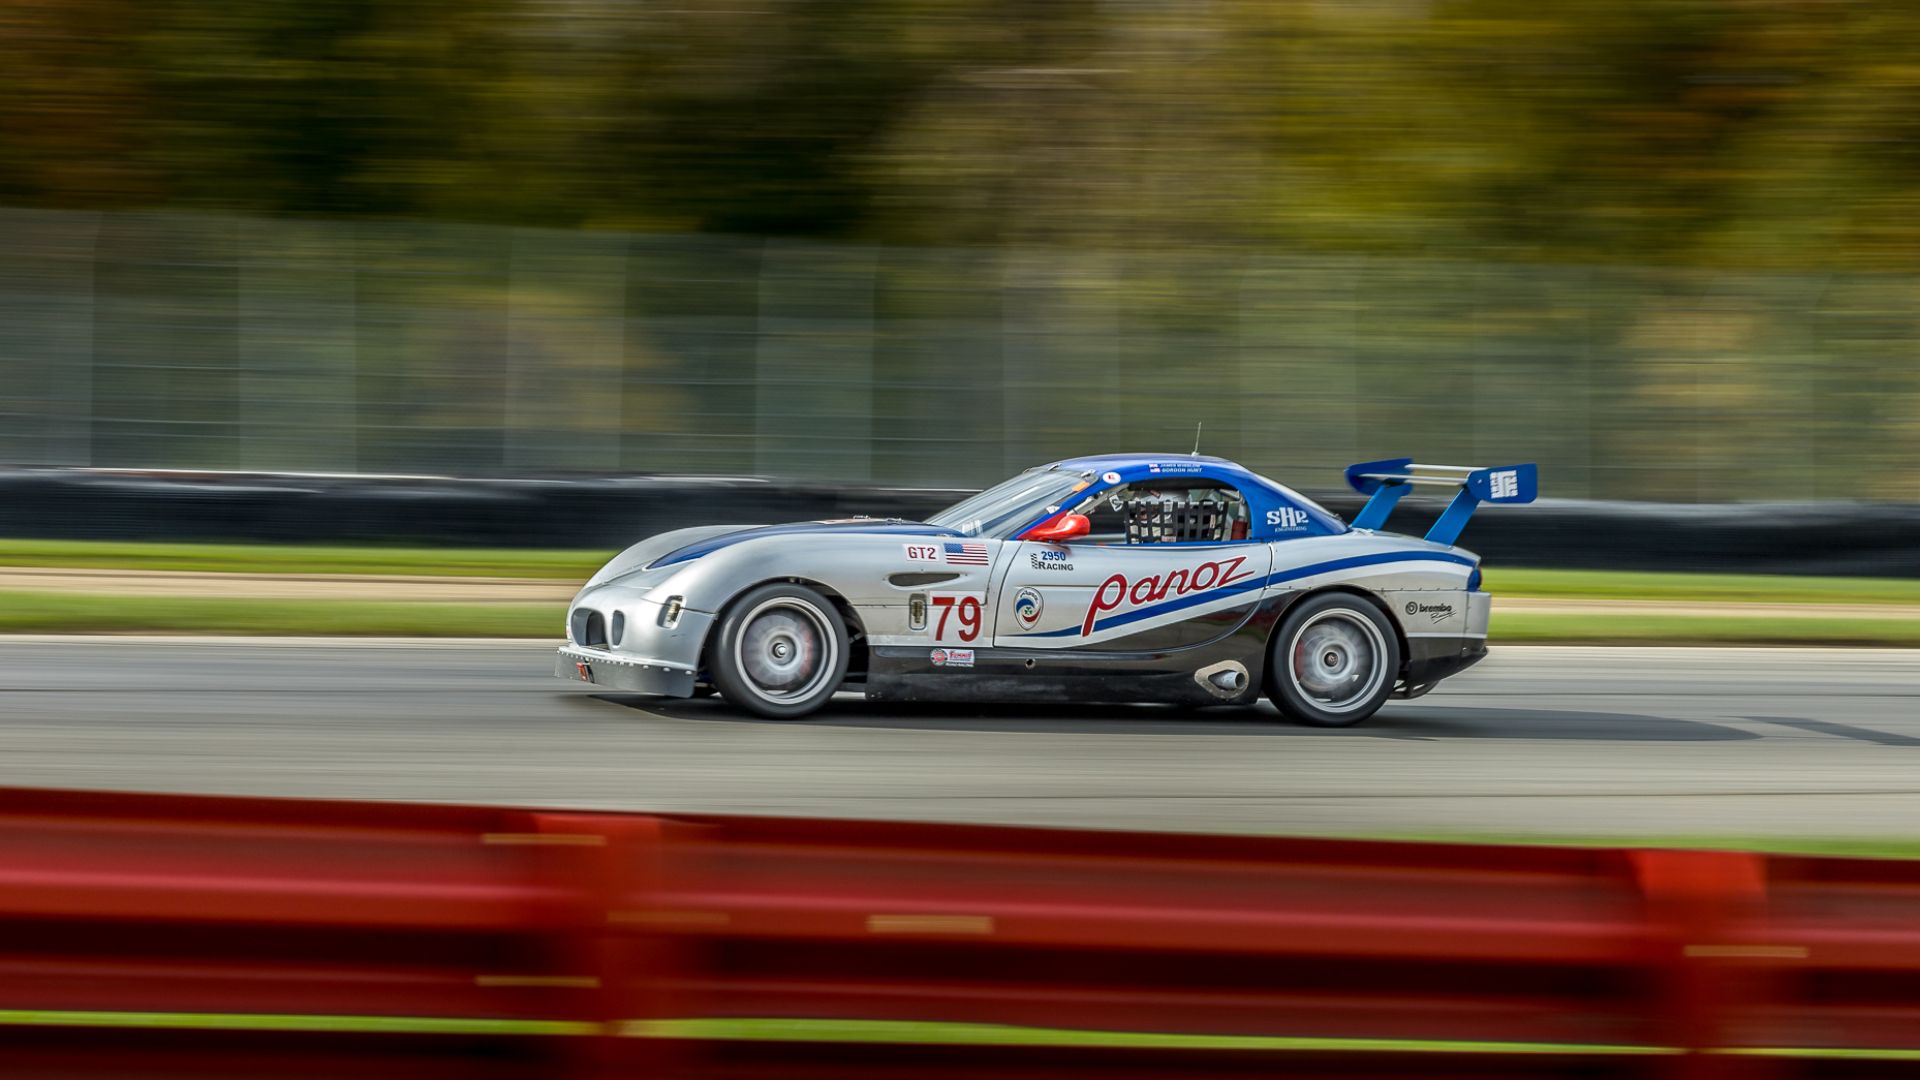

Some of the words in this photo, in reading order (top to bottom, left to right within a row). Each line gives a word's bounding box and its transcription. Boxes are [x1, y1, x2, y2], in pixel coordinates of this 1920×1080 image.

[908, 546, 936, 559] GT2
[1041, 551, 1066, 561] 2950
[1038, 561, 1074, 571] RACING
[1419, 603, 1452, 612] brembo
[932, 596, 981, 642] 79
